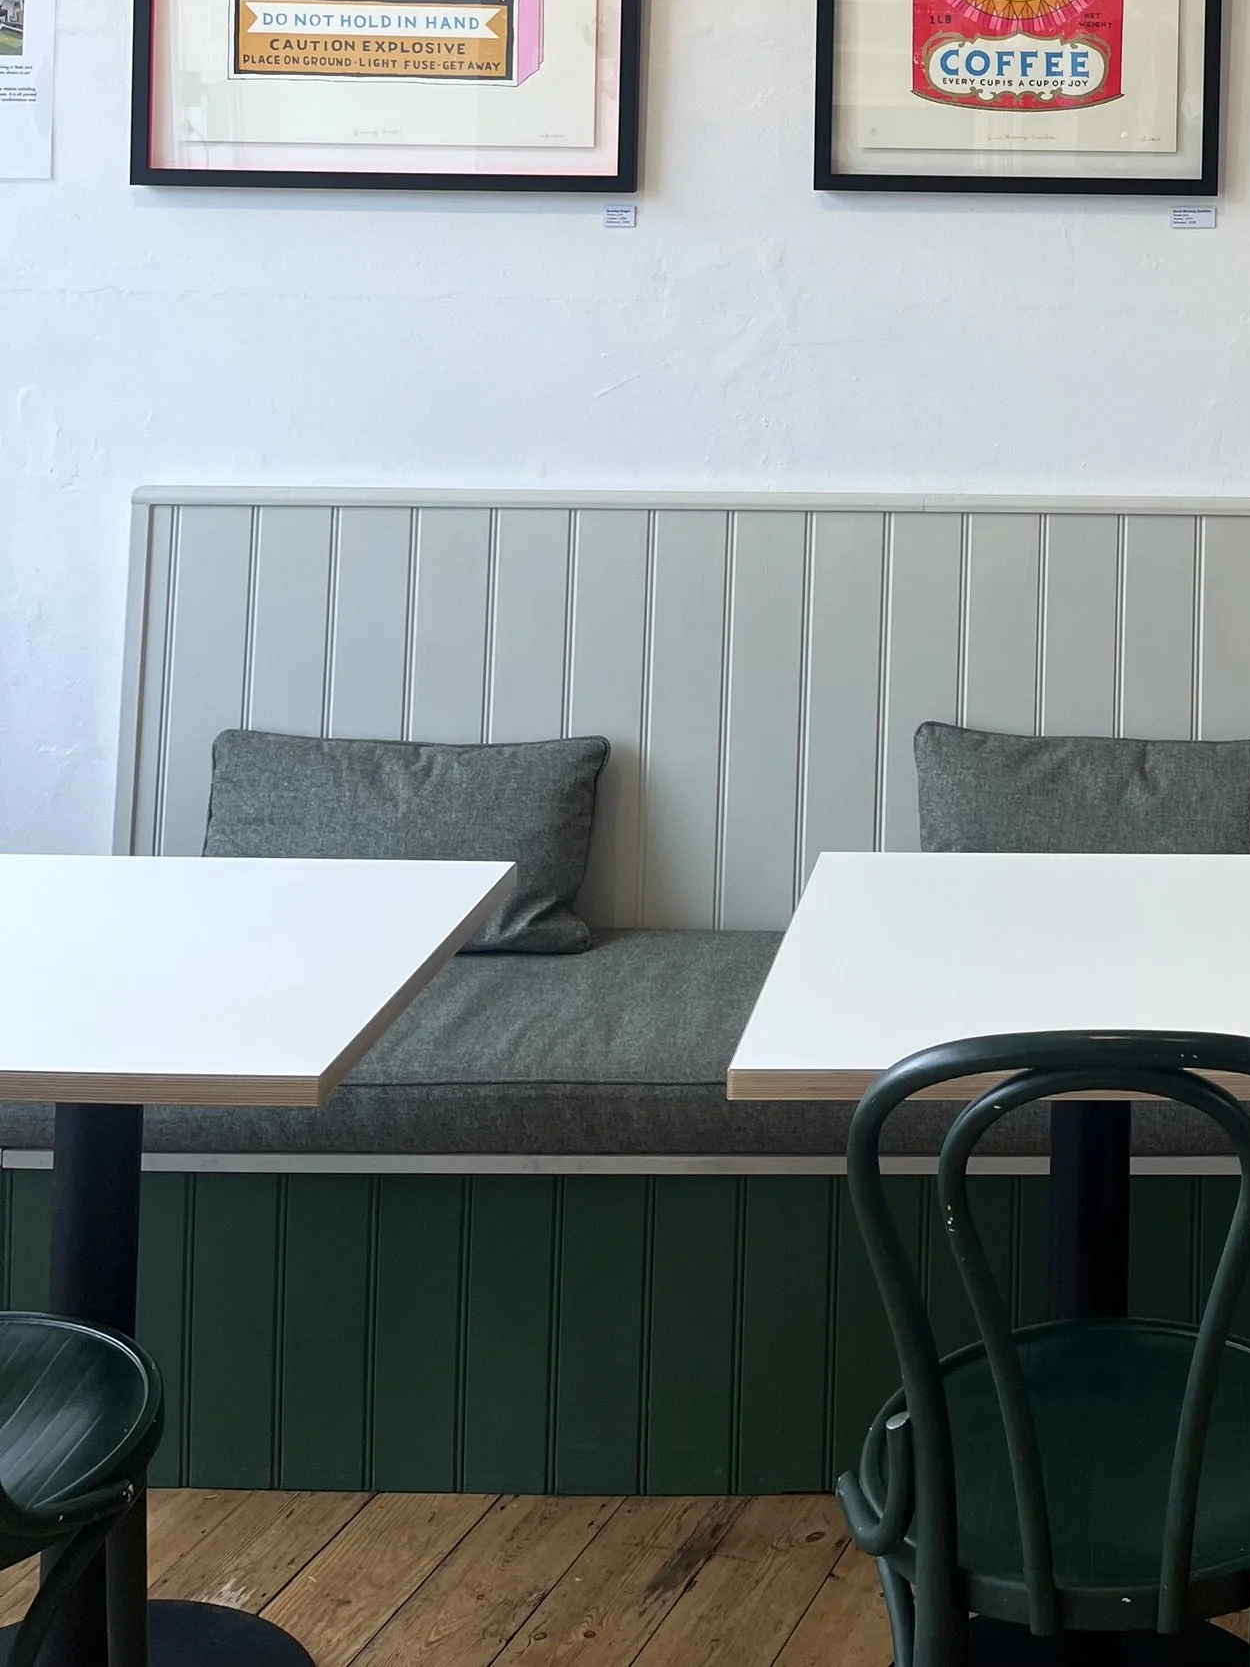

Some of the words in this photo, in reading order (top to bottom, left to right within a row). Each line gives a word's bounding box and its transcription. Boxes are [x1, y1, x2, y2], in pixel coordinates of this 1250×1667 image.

[263, 13, 288, 25] DO
[294, 13, 334, 27] NOT
[340, 14, 391, 28] HOLD
[397, 15, 417, 29] IN
[425, 15, 480, 30] HAND
[269, 38, 356, 52] CAUTION
[363, 40, 466, 54] EXPLOSIVE
[243, 54, 280, 65] PLACE
[284, 56, 300, 65] ON
[467, 60, 501, 71] AWAY
[940, 49, 1090, 78] COFFEE
[943, 77, 975, 85] EVERY
[980, 78, 1000, 86] CUP
[1002, 79, 1013, 87] IS
[1018, 79, 1025, 87] A
[1029, 79, 1051, 87] CUP
[1068, 79, 1089, 87] JOY
